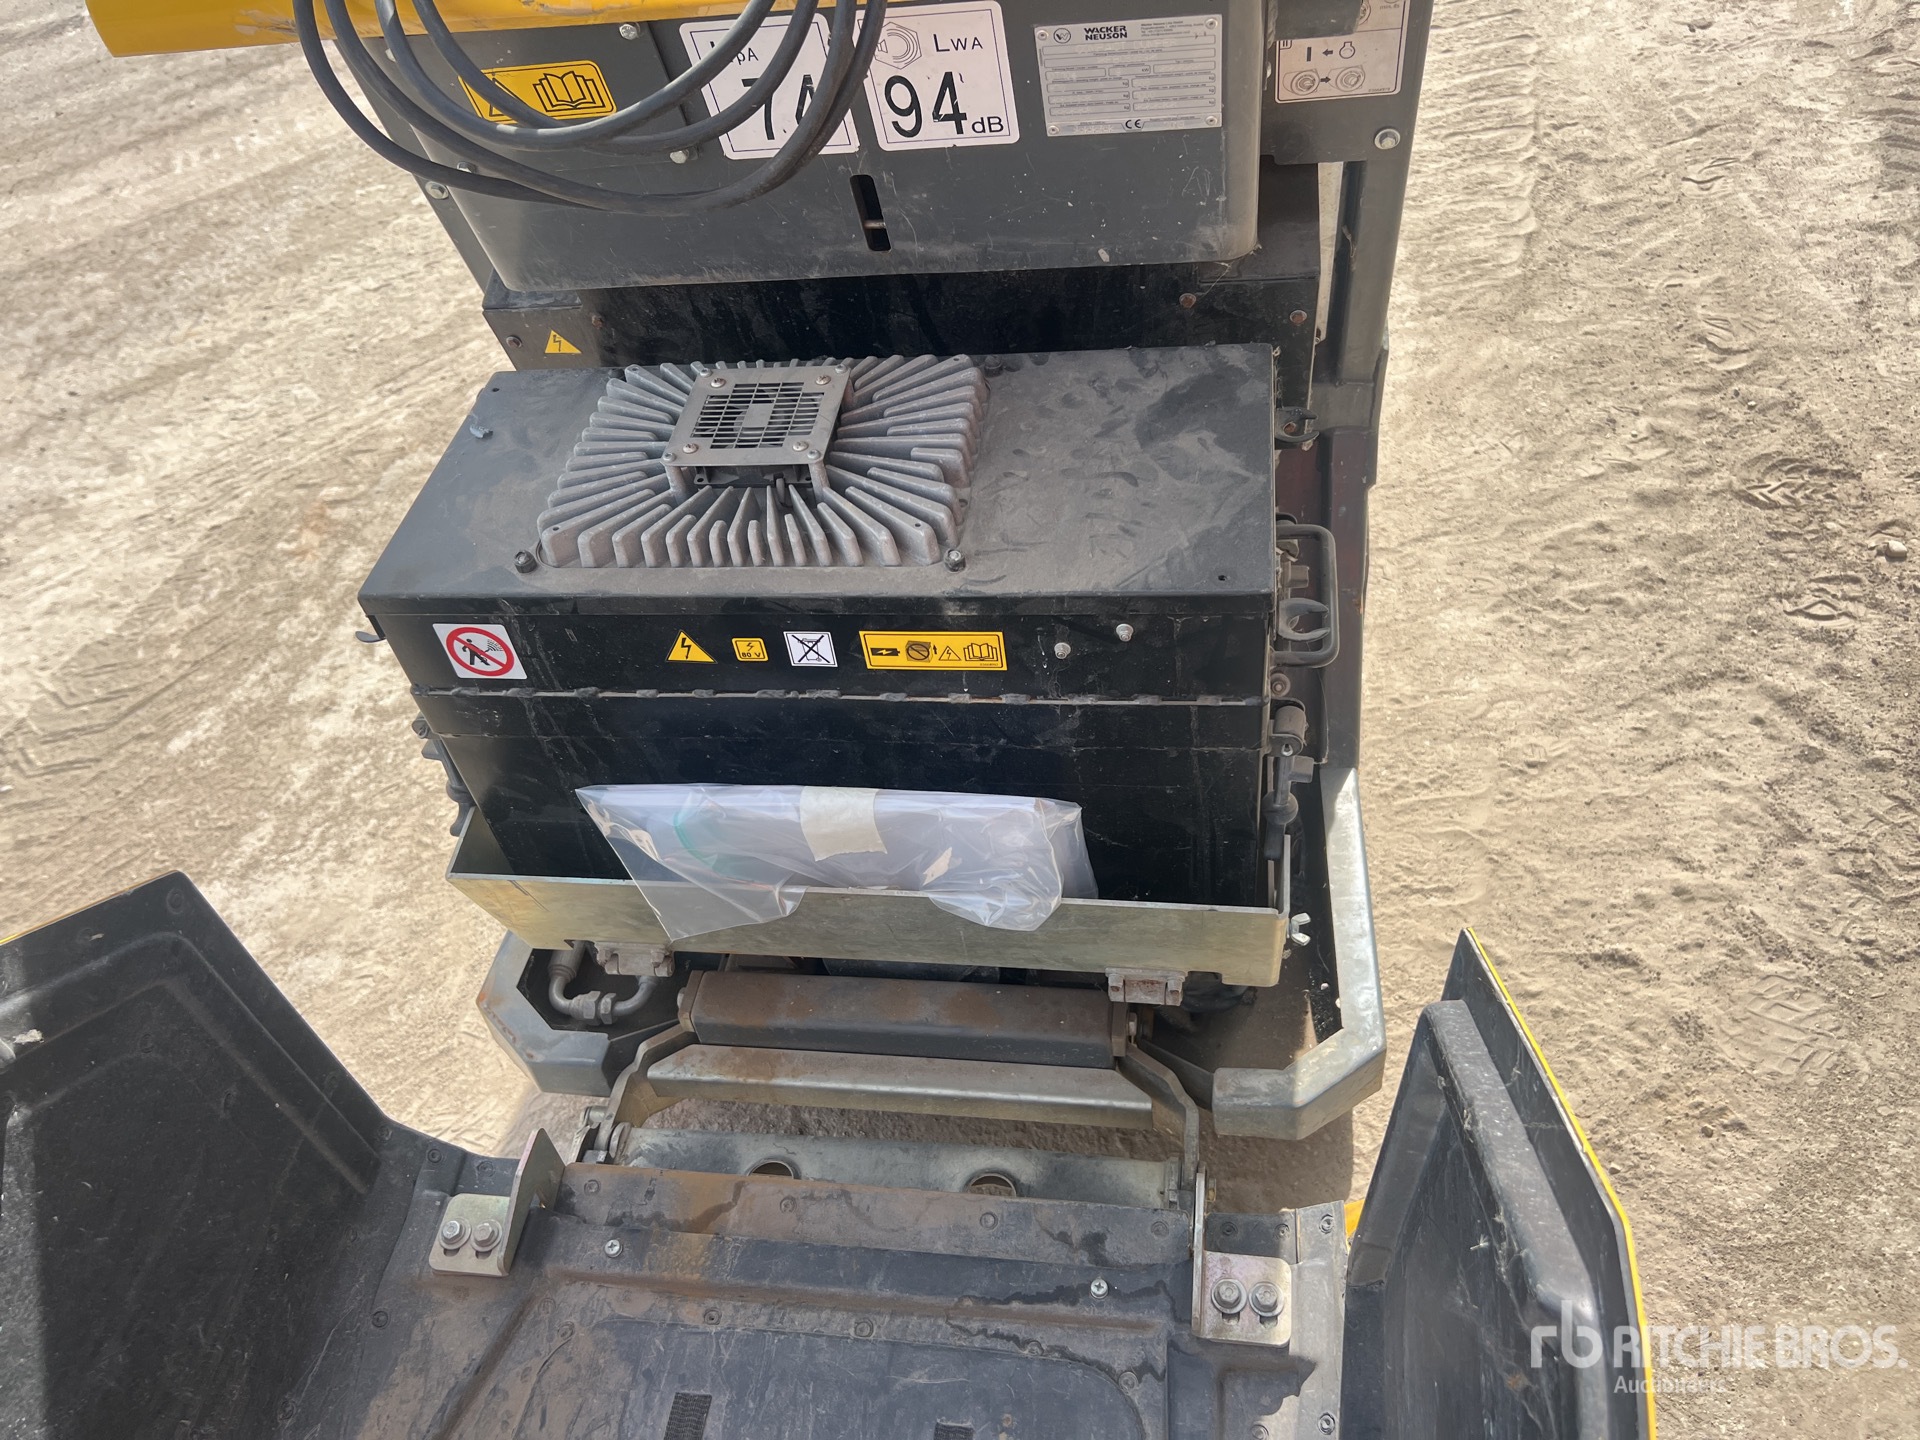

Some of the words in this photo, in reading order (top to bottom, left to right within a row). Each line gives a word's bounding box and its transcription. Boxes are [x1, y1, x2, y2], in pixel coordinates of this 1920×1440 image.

[1084, 25, 1127, 35] WACKER
[1085, 31, 1128, 41] NEUSON
[884, 71, 967, 138] 94
[972, 115, 1004, 134] dB
